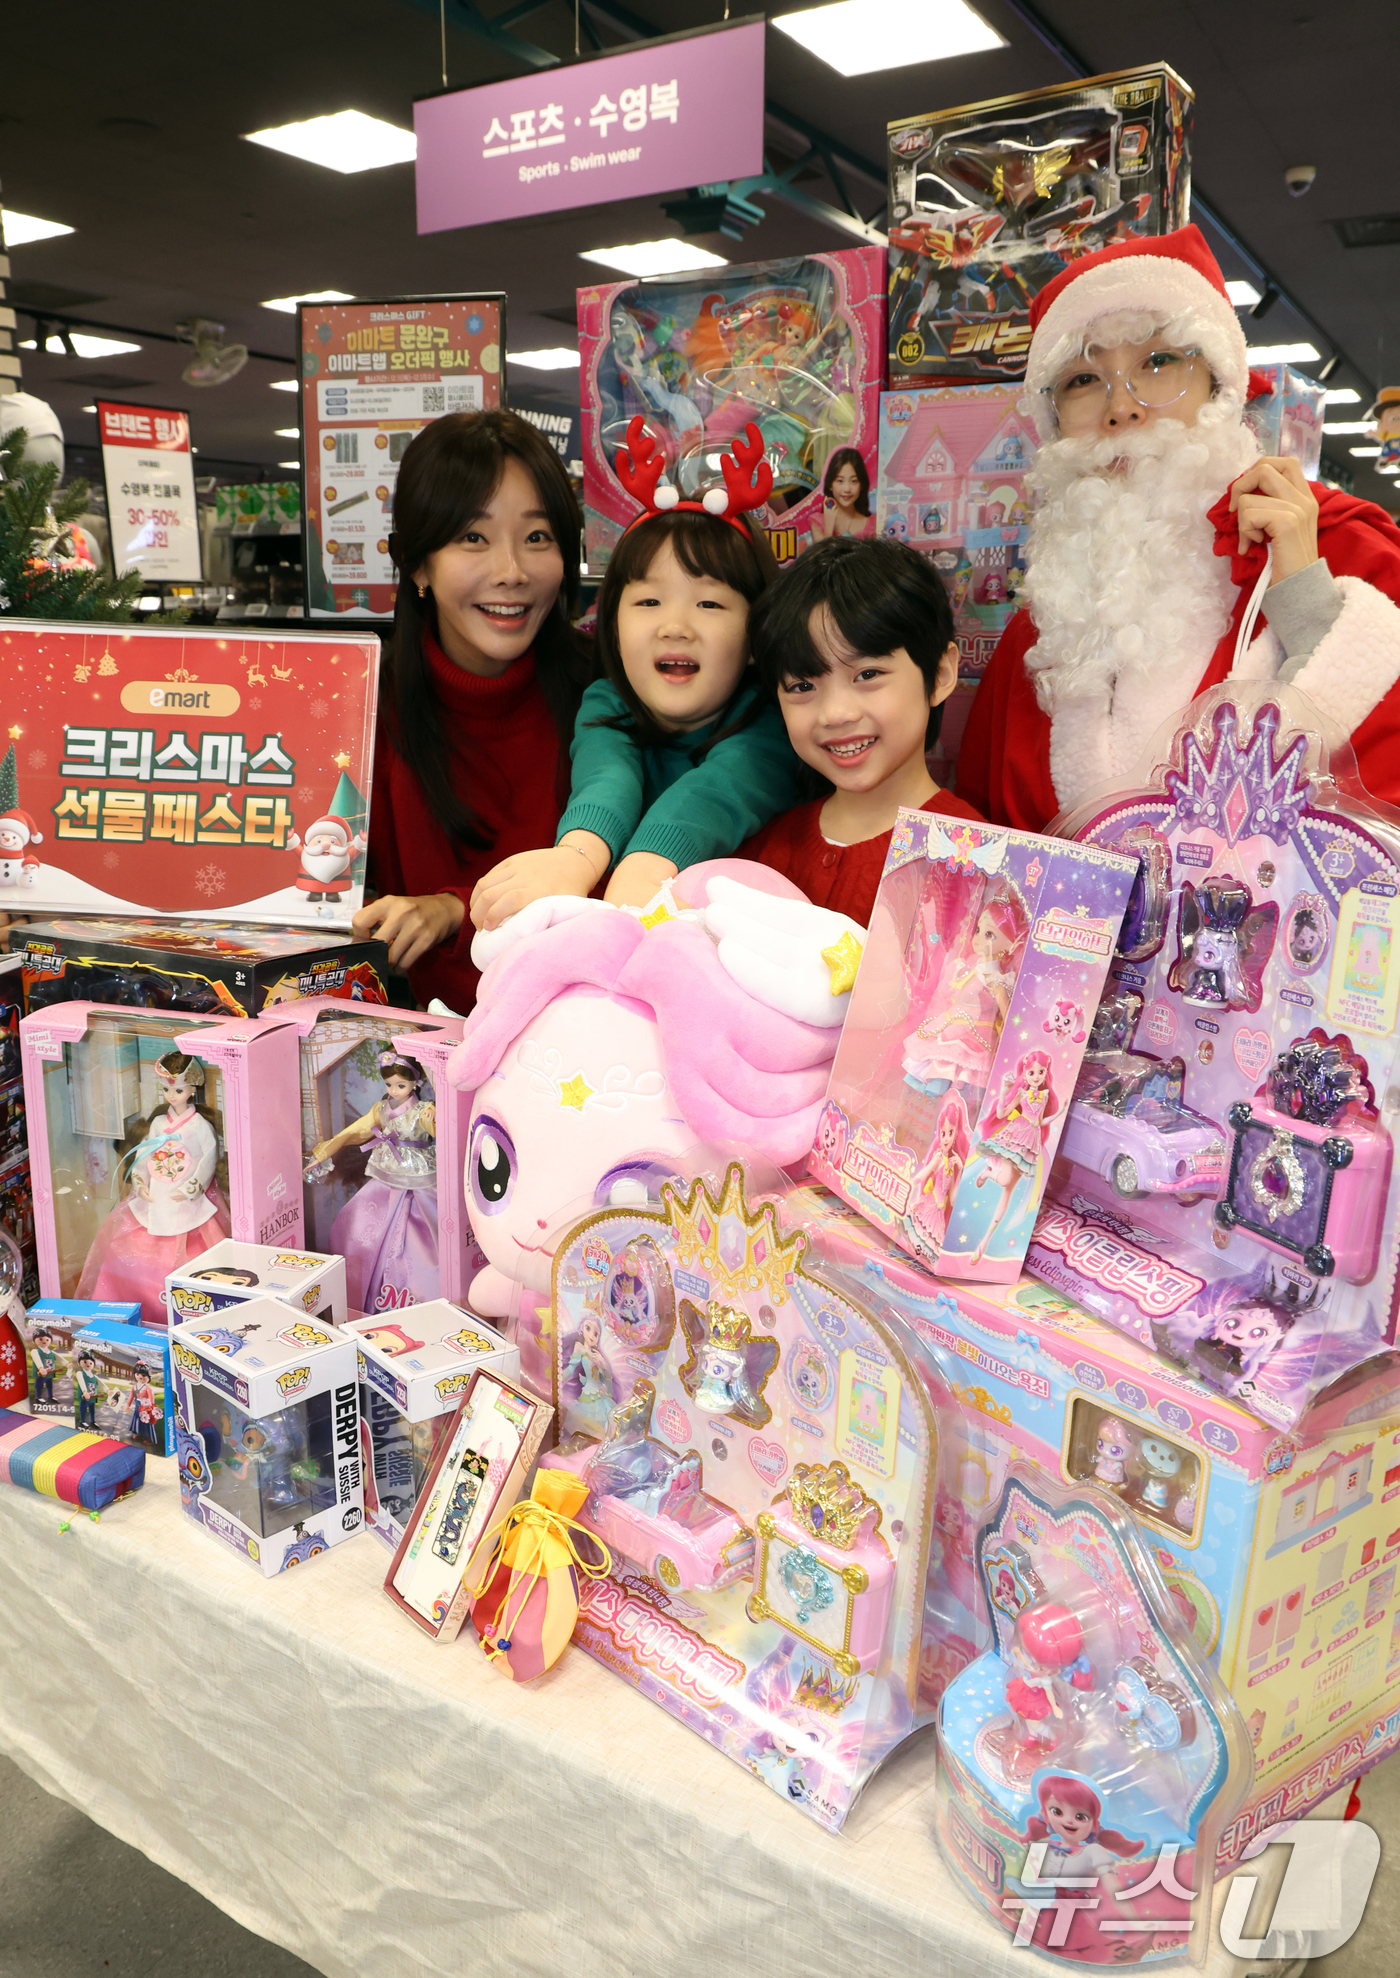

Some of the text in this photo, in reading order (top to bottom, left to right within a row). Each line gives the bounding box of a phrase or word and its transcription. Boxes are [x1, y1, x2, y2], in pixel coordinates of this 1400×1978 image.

[482, 79, 680, 159] 스포츠 수영복
[519, 146, 642, 183] Sports Swim wear
[406, 310, 426, 320] GIFT
[347, 324, 449, 351] 이마트 문완구
[328, 349, 471, 372] 이마트앱 오더픽 행사
[902, 344, 919, 357] 002
[105, 411, 183, 441] 브랜드 행사
[121, 482, 150, 497] 수영복
[149, 688, 210, 709] emart
[60, 726, 295, 787] 크리스마스
[1330, 852, 1345, 867] 3+
[1037, 921, 1109, 955] 브라잇하트
[235, 971, 246, 980] 3+
[299, 968, 346, 992] 미니특공대
[26, 1031, 50, 1044] Mimi
[36, 1044, 58, 1054] style
[844, 1147, 908, 1215] 브라잇하트
[260, 1208, 299, 1245] HANBOK
[277, 1254, 325, 1268] POP!
[1070, 1230, 1194, 1308] 이클립스핑
[1042, 1258, 1090, 1301] Eclipseping
[170, 1288, 213, 1312] POP!
[302, 1284, 321, 1308] POP!
[28, 1318, 72, 1329] playmobil
[825, 1313, 838, 1326] 3+
[74, 1339, 112, 1354] playmobil
[283, 1323, 333, 1346] POP!
[448, 1329, 495, 1353] POP!
[172, 1344, 200, 1375] POP!
[957, 1338, 988, 1369] 불빛이
[989, 1359, 1019, 1386] 나오는
[1020, 1371, 1048, 1397] 욕조!
[1084, 1365, 1096, 1376] AAA
[276, 1367, 310, 1393] POP!
[435, 1374, 470, 1398] POP!
[33, 1403, 56, 1412] 72015
[499, 1394, 527, 1414] BOOKMARK
[500, 1405, 523, 1422] BALLPEN
[335, 1382, 359, 1469] DERPY
[1212, 1427, 1228, 1440] 3+
[339, 1464, 350, 1505] SUSSIE
[349, 1459, 361, 1489] WITH
[210, 1509, 232, 1533] DERPY
[343, 1511, 361, 1528] 2260
[624, 1575, 671, 1608] 영광의 티니핑
[806, 1789, 838, 1816] SAMG
[1217, 1790, 1284, 1857] 티니핑
[1283, 1740, 1363, 1816] 프린세스
